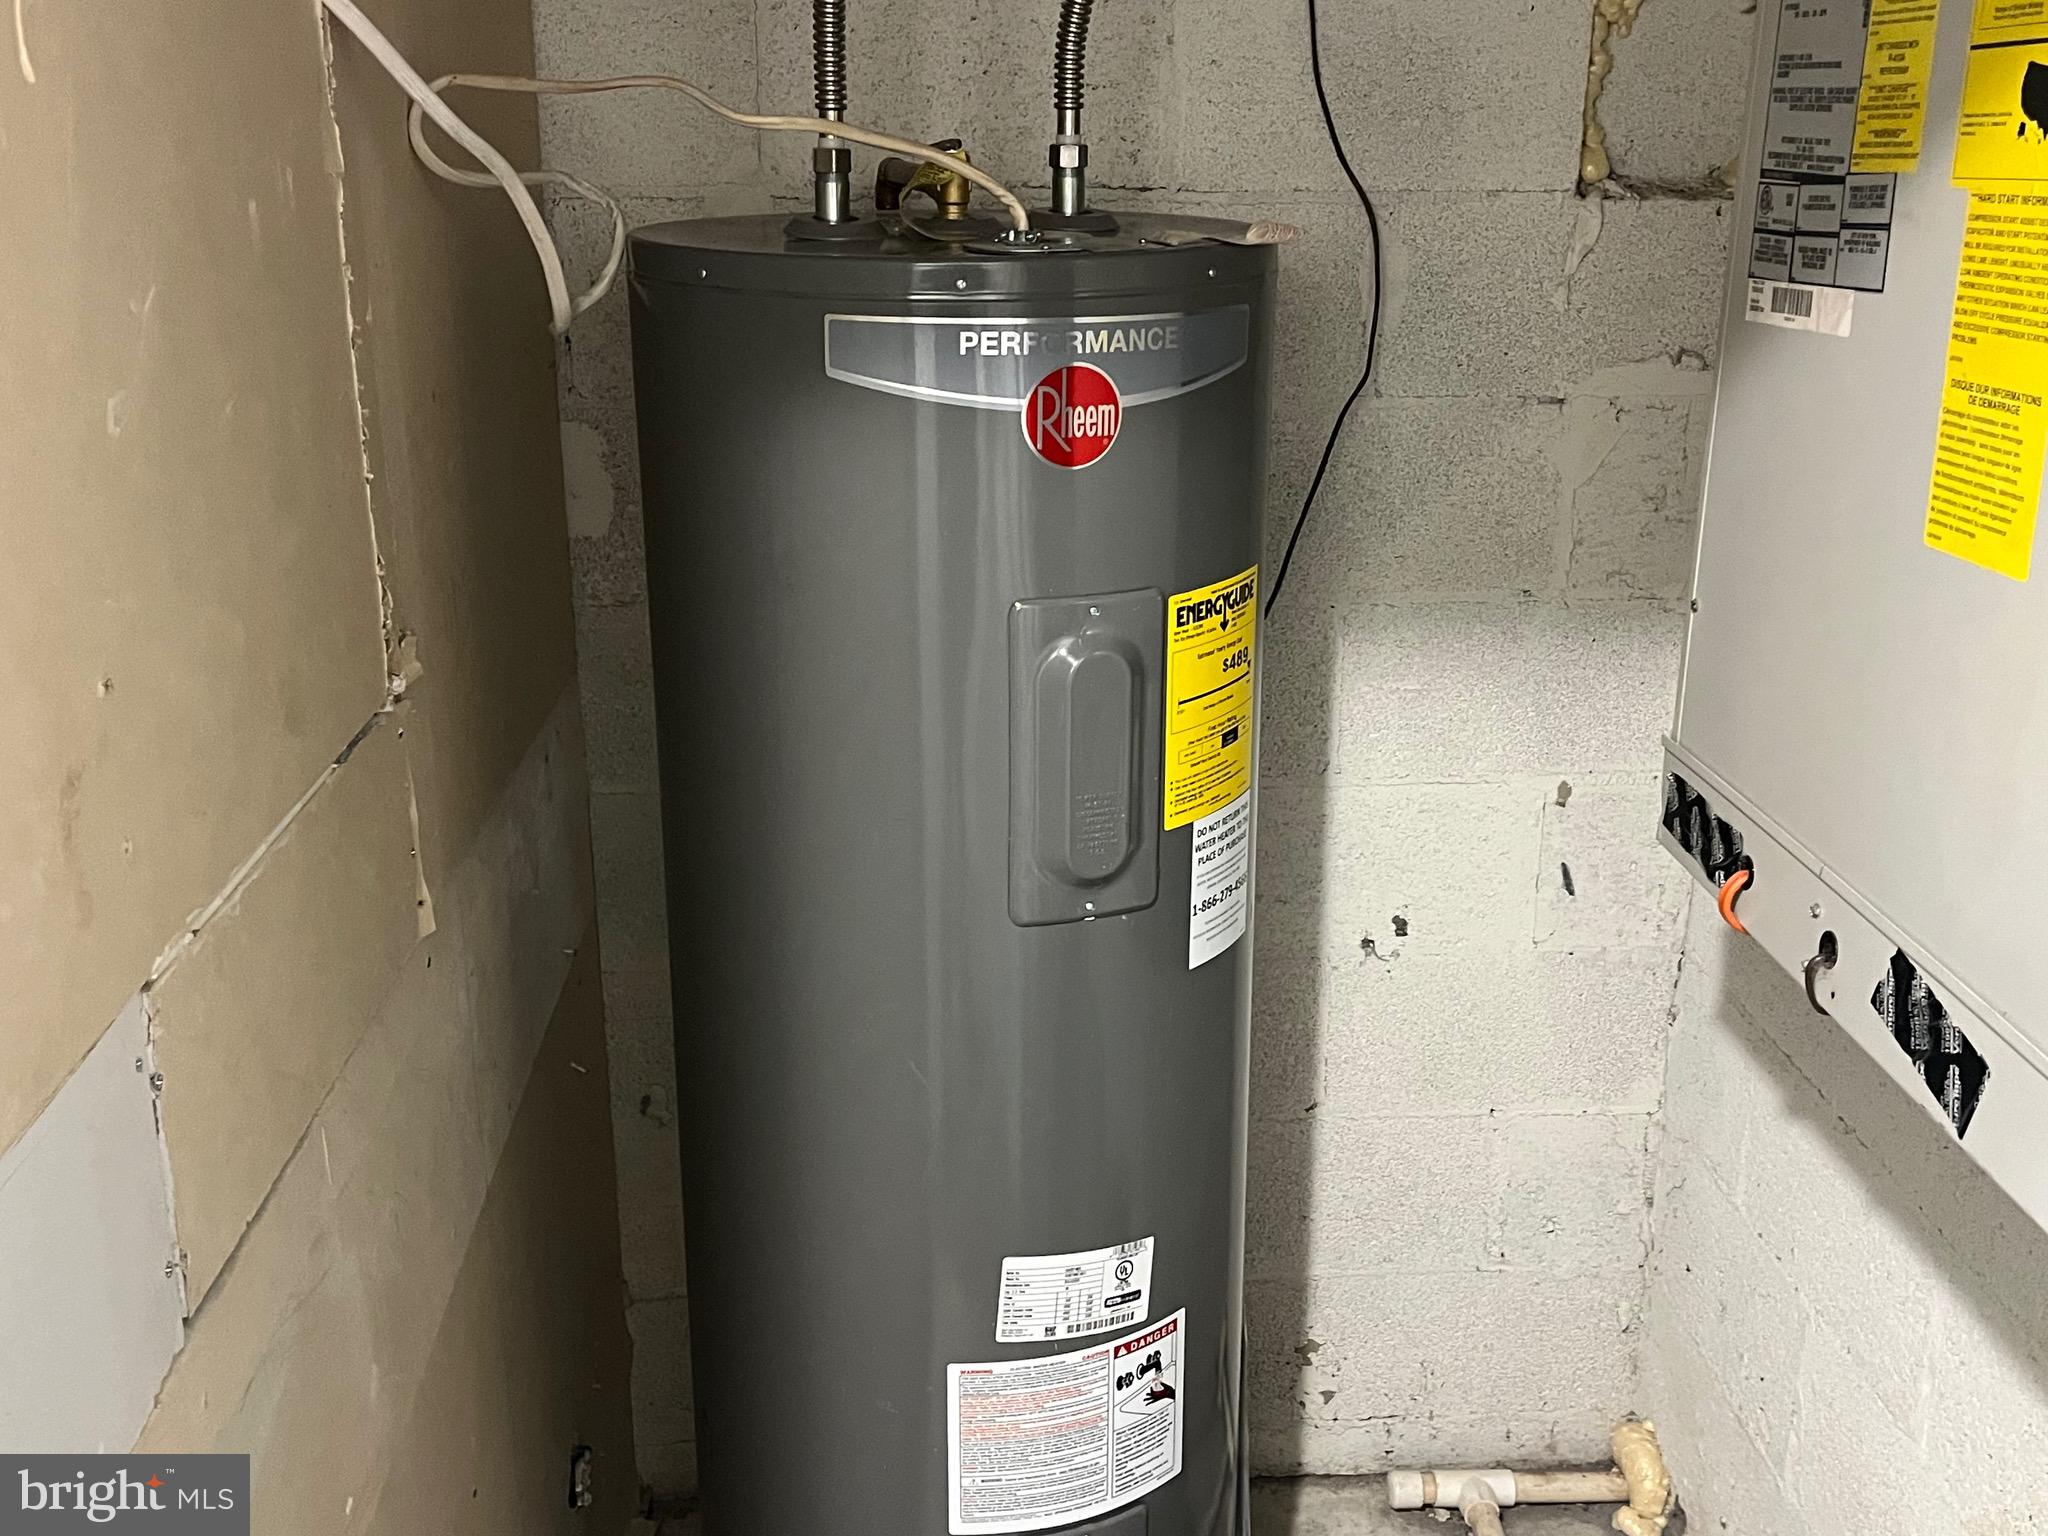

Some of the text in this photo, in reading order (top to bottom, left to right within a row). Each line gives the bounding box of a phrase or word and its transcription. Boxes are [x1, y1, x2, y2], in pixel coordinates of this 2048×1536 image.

[1998, 194, 2020, 204] START
[959, 326, 1180, 356] PERFORMANCE
[1037, 367, 1116, 453] Rheem
[1991, 387, 2042, 407] INFORMATIONS
[1222, 646, 1249, 673] $489
[1197, 826, 1207, 838] DO
[1208, 820, 1221, 832] NOT
[1222, 808, 1240, 825] RETURN
[1195, 835, 1216, 854] WATER
[1217, 824, 1236, 842] HEATER
[1198, 850, 1216, 867] PLACE
[1217, 845, 1224, 857] OF
[1130, 1323, 1174, 1351] DANGER
